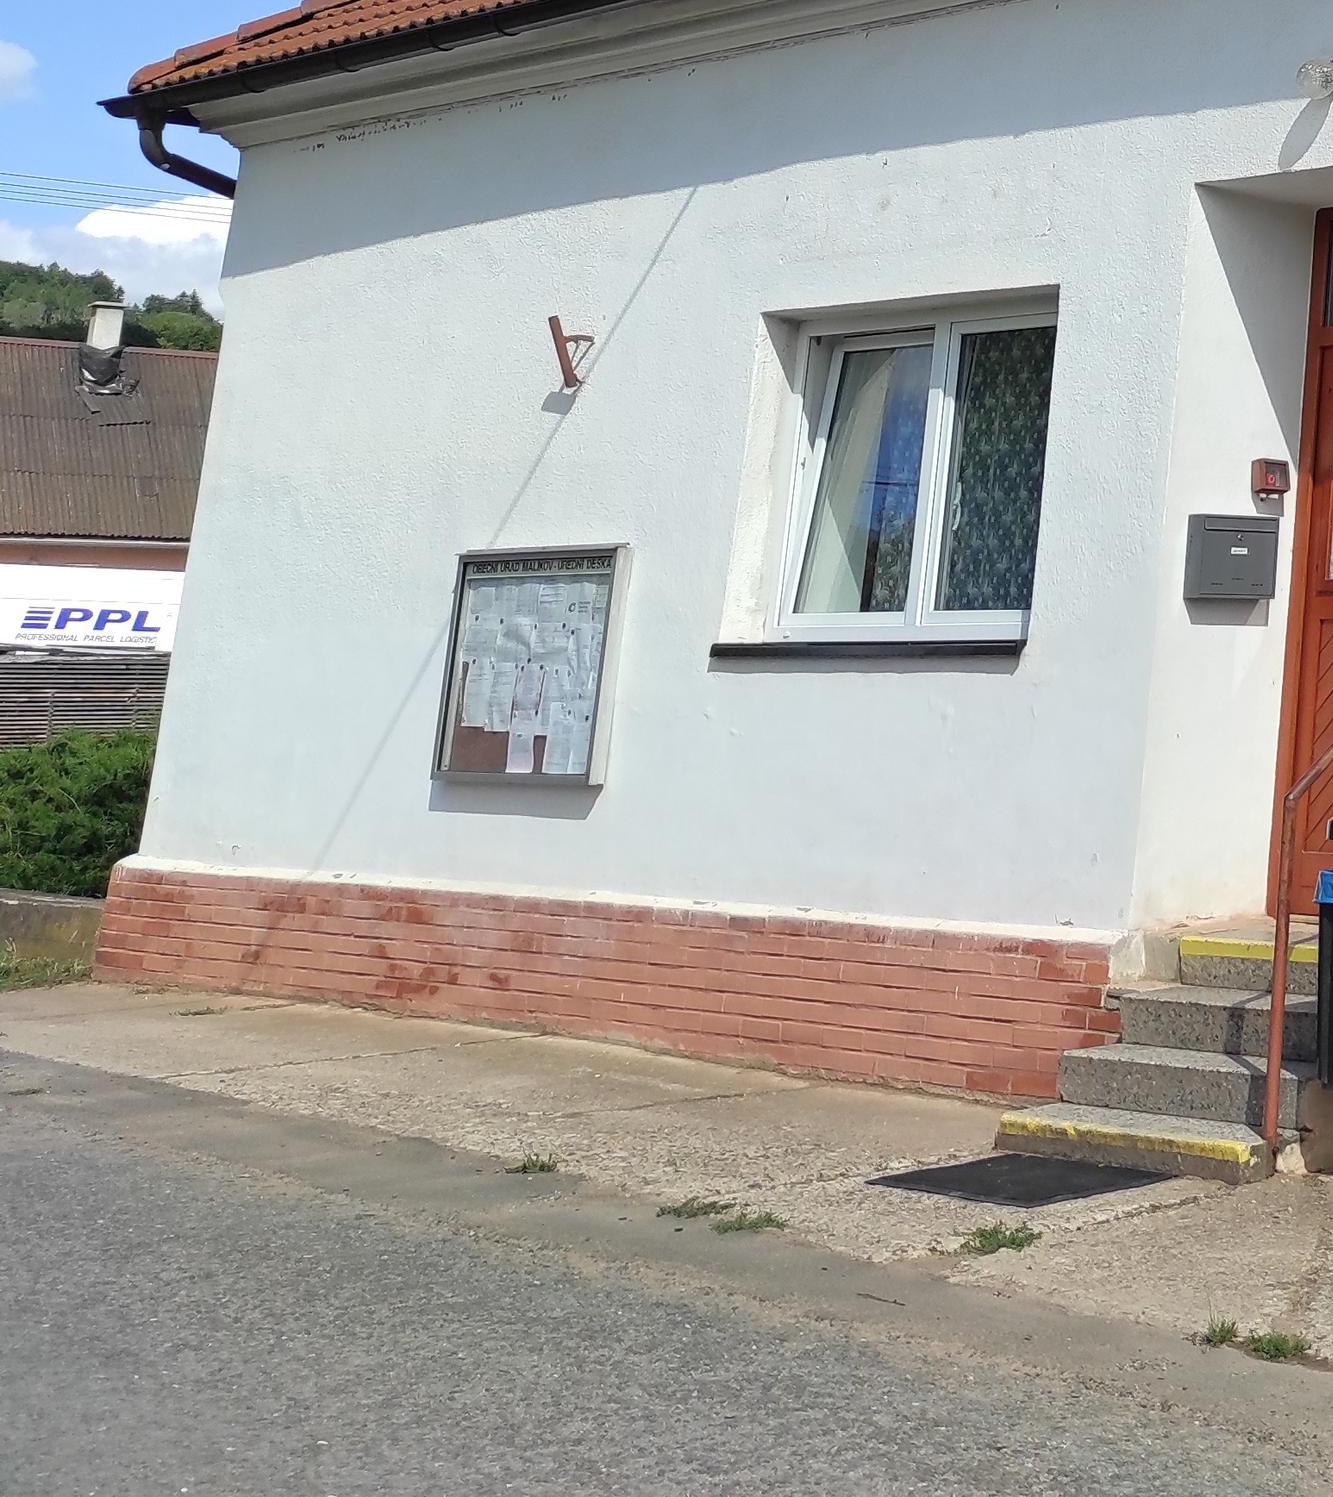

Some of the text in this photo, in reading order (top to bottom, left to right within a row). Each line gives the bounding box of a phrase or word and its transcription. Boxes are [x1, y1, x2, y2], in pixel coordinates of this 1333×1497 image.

[54, 607, 161, 632] PPL
[15, 632, 79, 642] PROFESSIONAL
[84, 634, 115, 643] PARCEL
